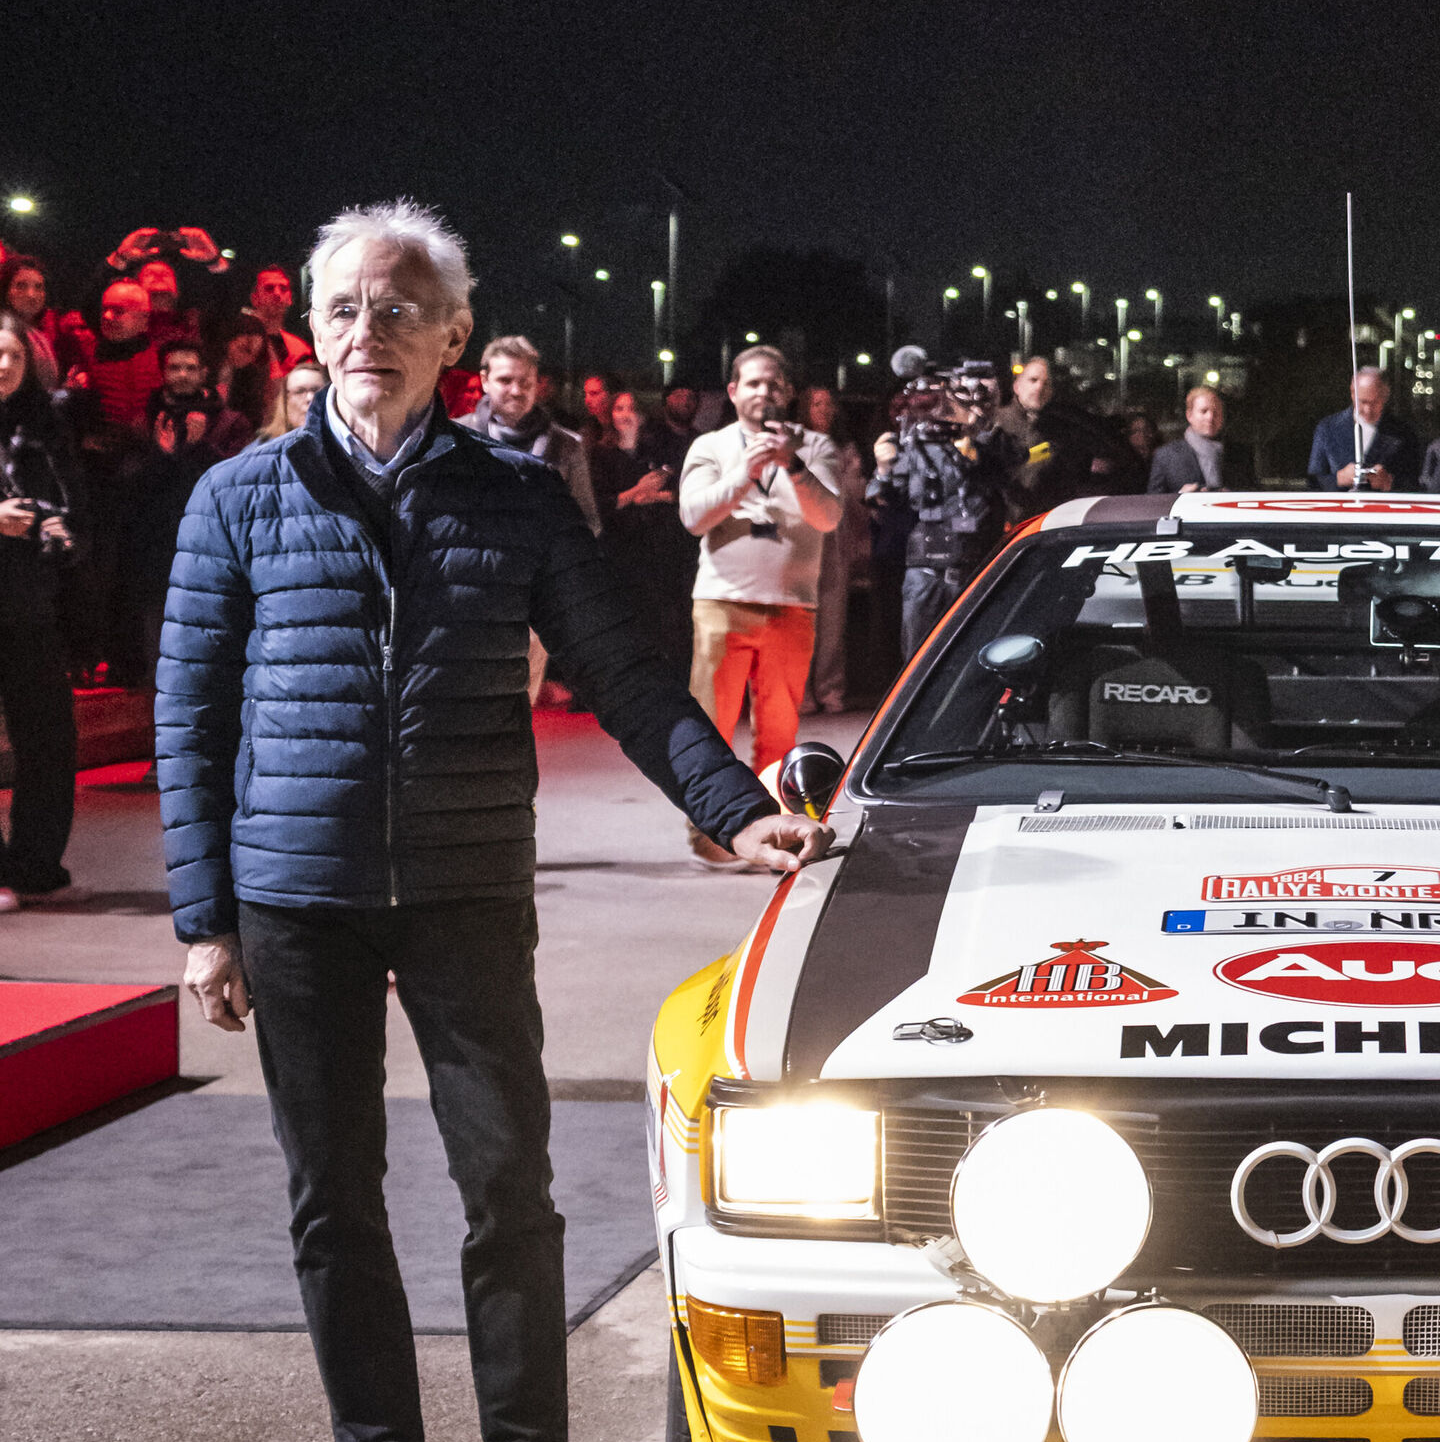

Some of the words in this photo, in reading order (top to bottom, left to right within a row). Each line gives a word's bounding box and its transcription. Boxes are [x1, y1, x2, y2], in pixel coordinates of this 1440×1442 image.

[1061, 541, 1194, 568] HB
[1104, 682, 1212, 705] RECARO
[1272, 870, 1322, 883] 1984
[1372, 870, 1397, 882] 7
[1221, 877, 1321, 898] RALLYE
[1233, 912, 1318, 928] IN
[1014, 963, 1123, 993] HB
[984, 991, 1149, 1004] international
